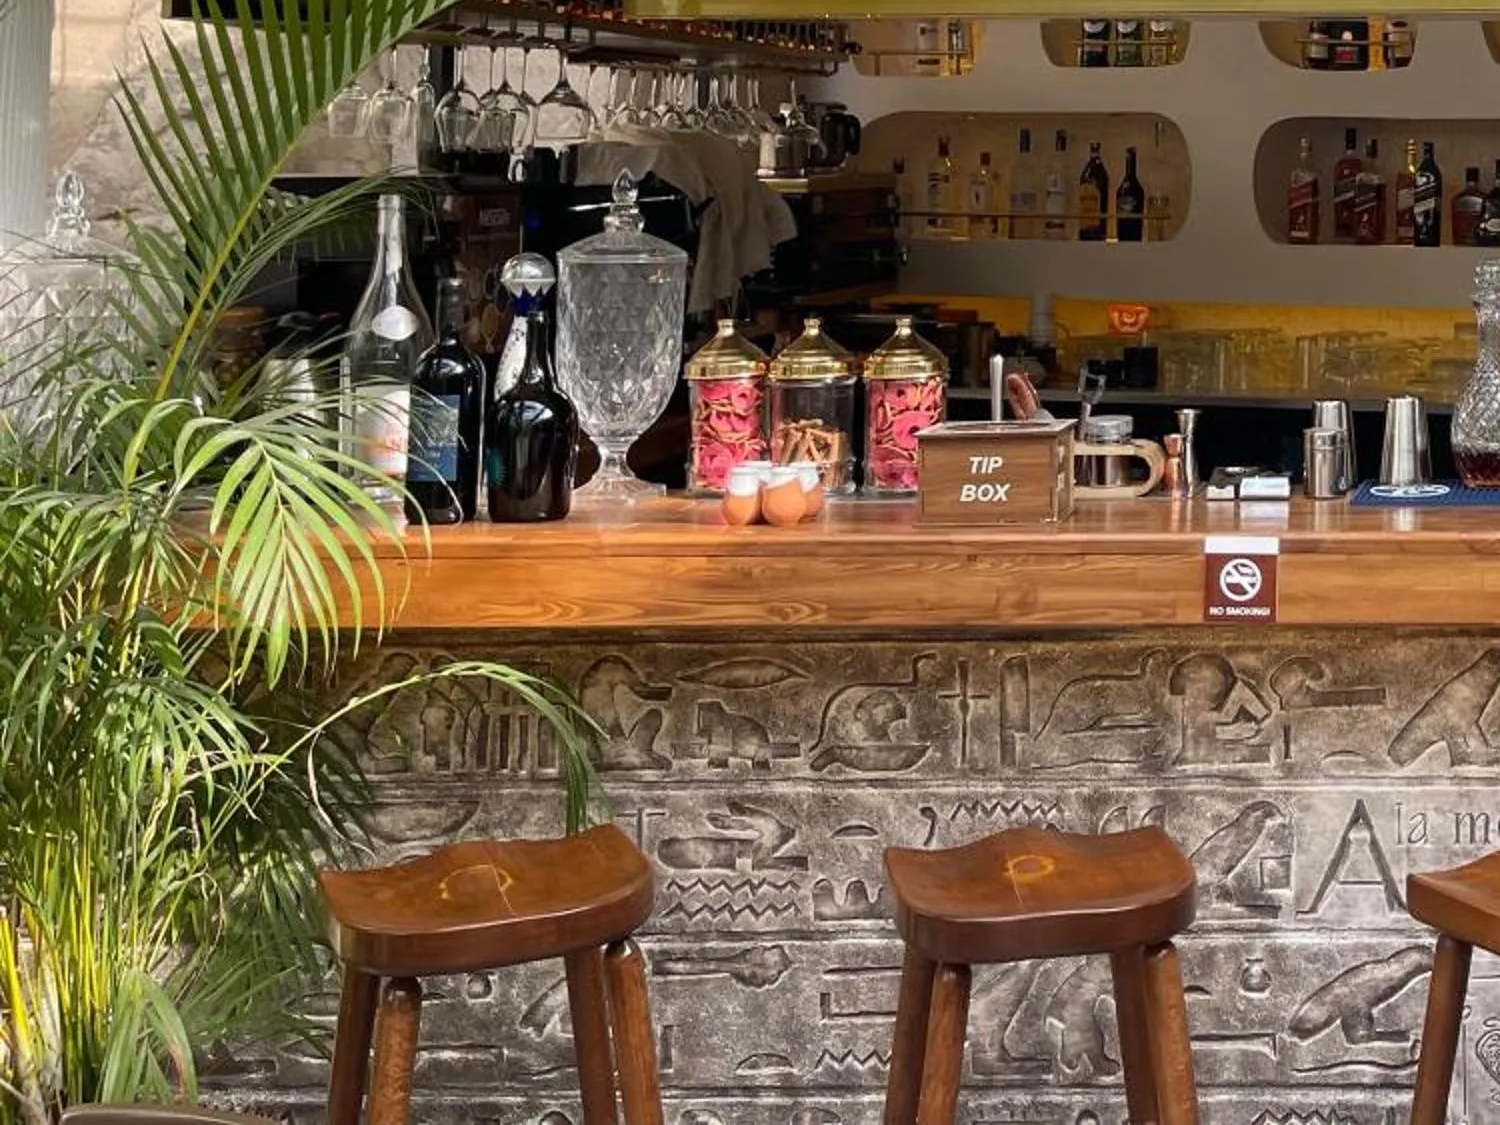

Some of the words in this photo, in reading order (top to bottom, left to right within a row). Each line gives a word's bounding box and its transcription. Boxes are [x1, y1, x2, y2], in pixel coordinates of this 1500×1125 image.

[968, 456, 1003, 474] TIP
[959, 483, 1011, 502] BOX
[1209, 606, 1225, 616] NO
[1296, 799, 1407, 914] A
[1395, 802, 1429, 845] la
